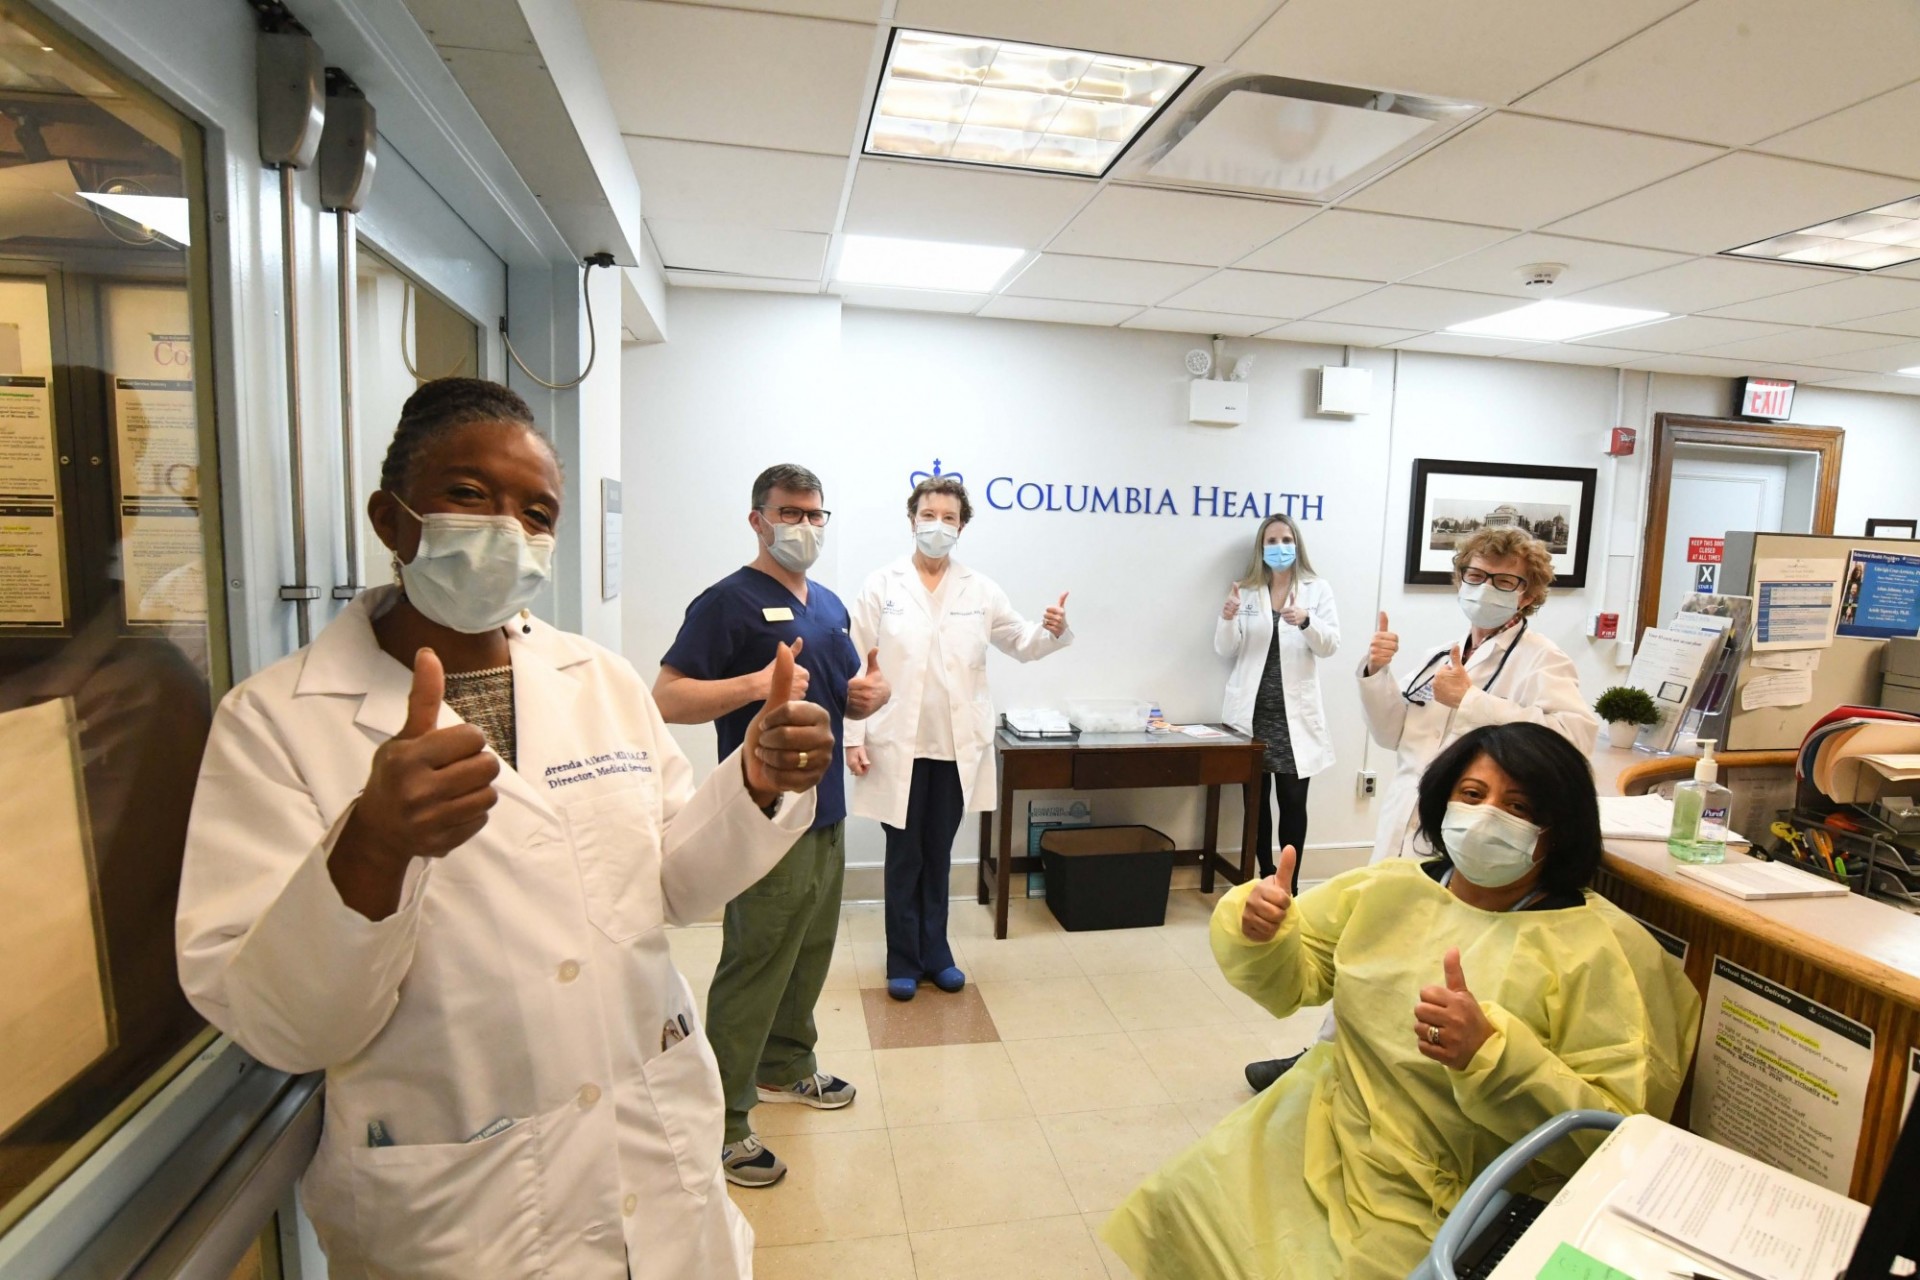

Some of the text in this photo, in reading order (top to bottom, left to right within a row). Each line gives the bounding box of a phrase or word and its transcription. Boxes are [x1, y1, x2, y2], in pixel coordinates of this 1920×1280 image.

[1750, 380, 1790, 416] EXIT
[986, 477, 1324, 521] COLUMBIA HEALTH
[1700, 566, 1713, 582] X
[548, 772, 596, 789] Director,
[596, 764, 627, 776] Medical
[1719, 964, 1791, 1004] Virtual Service Delivery
[1721, 1001, 1751, 1021] Compliance
[1753, 1018, 1769, 1031] Office
[1798, 1041, 1820, 1058] support
[1734, 1000, 1758, 1017] Columbia
[1759, 1014, 1776, 1026] Health
[1779, 1024, 1819, 1049] Immunization
[1816, 1011, 1847, 1030] COLUMBIA
[1716, 1033, 1732, 1047] Office
[1743, 1048, 1766, 1066] provide
[1768, 1062, 1792, 1081] services
[1794, 1077, 1820, 1097] virtually
[1738, 1054, 1756, 1068] March
[1742, 1034, 1757, 1046] public
[1759, 1044, 1776, 1056] health
[1778, 1054, 1804, 1071] guidance
[1806, 1069, 1827, 1084] around
[1756, 1049, 1797, 1075] Immunization
[1798, 1072, 1837, 1098] Compliance
[1808, 1125, 1831, 1142] support
